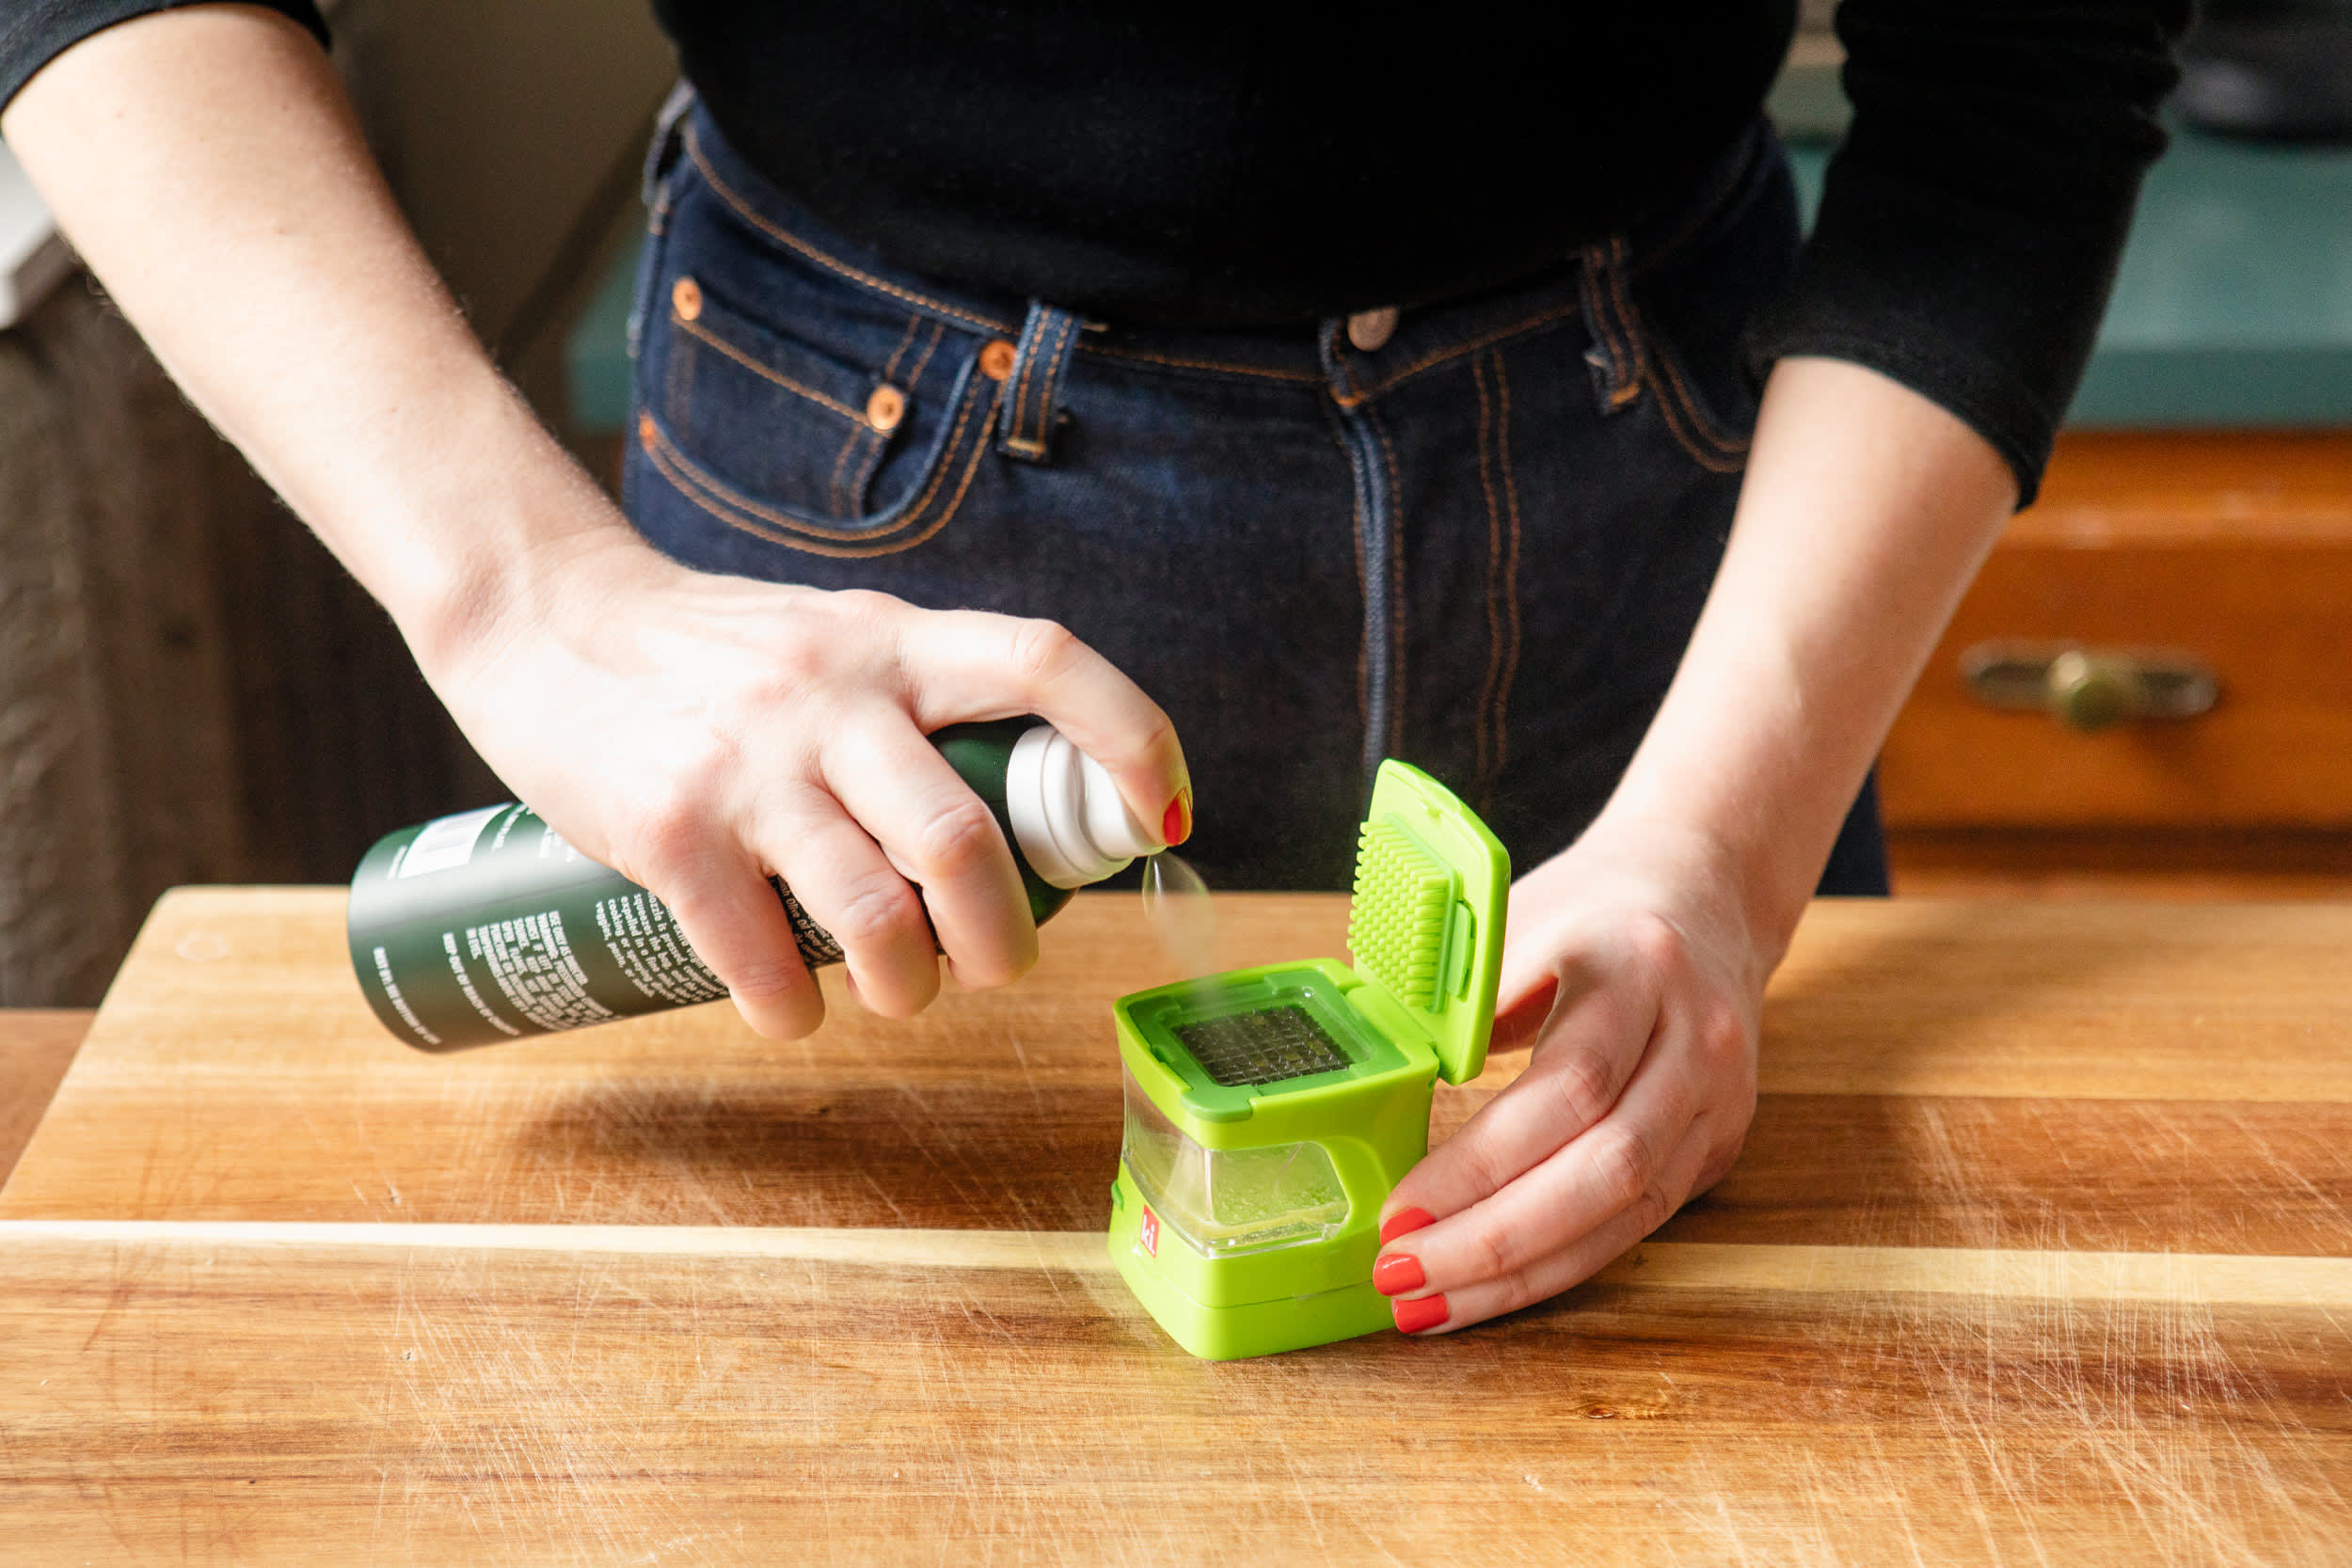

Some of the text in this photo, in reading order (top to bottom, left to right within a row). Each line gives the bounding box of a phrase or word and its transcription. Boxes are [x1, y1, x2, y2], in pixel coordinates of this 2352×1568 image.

[618, 895, 643, 937] expelled
[657, 923, 668, 931] is
[500, 920, 516, 943] OPEN
[525, 914, 541, 941] BURST
[535, 954, 554, 972] LEFT
[552, 925, 568, 946] ONLY
[606, 898, 626, 937] cooking
[619, 937, 631, 948] or
[625, 949, 653, 983] spraying
[633, 894, 654, 935] squeezes
[647, 935, 664, 952] the
[670, 969, 690, 983] and
[634, 937, 646, 948] in
[476, 926, 506, 979] TEMPERATURES
[487, 923, 511, 962] PUNCTURE
[501, 960, 516, 974] OR
[558, 943, 572, 957] AS
[606, 942, 627, 968] pasta,
[623, 968, 635, 977] or
[640, 948, 649, 957] a
[448, 955, 465, 974] OUT
[644, 957, 660, 973] fine
[455, 972, 471, 986] OF
[390, 996, 422, 1029] BOTTOM
